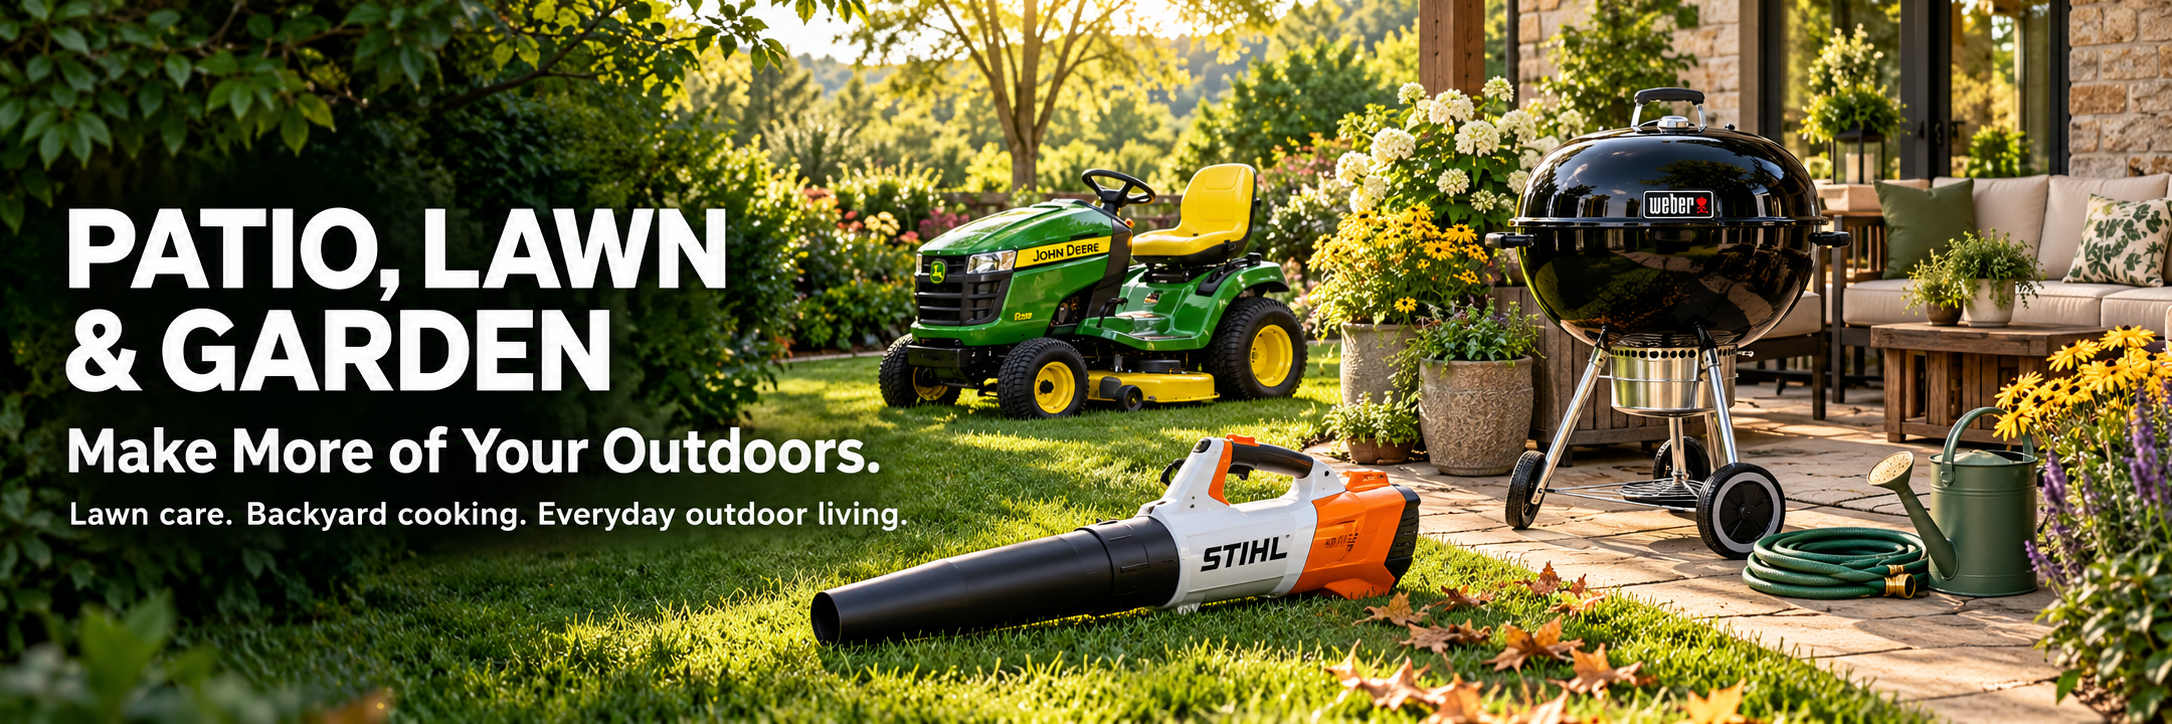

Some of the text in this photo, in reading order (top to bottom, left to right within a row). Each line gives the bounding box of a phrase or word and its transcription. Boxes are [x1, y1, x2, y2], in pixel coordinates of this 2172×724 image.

[1648, 193, 1695, 215] weber
[1033, 243, 1099, 262] JOHN DEERE
[1200, 536, 1288, 573] STIHL
